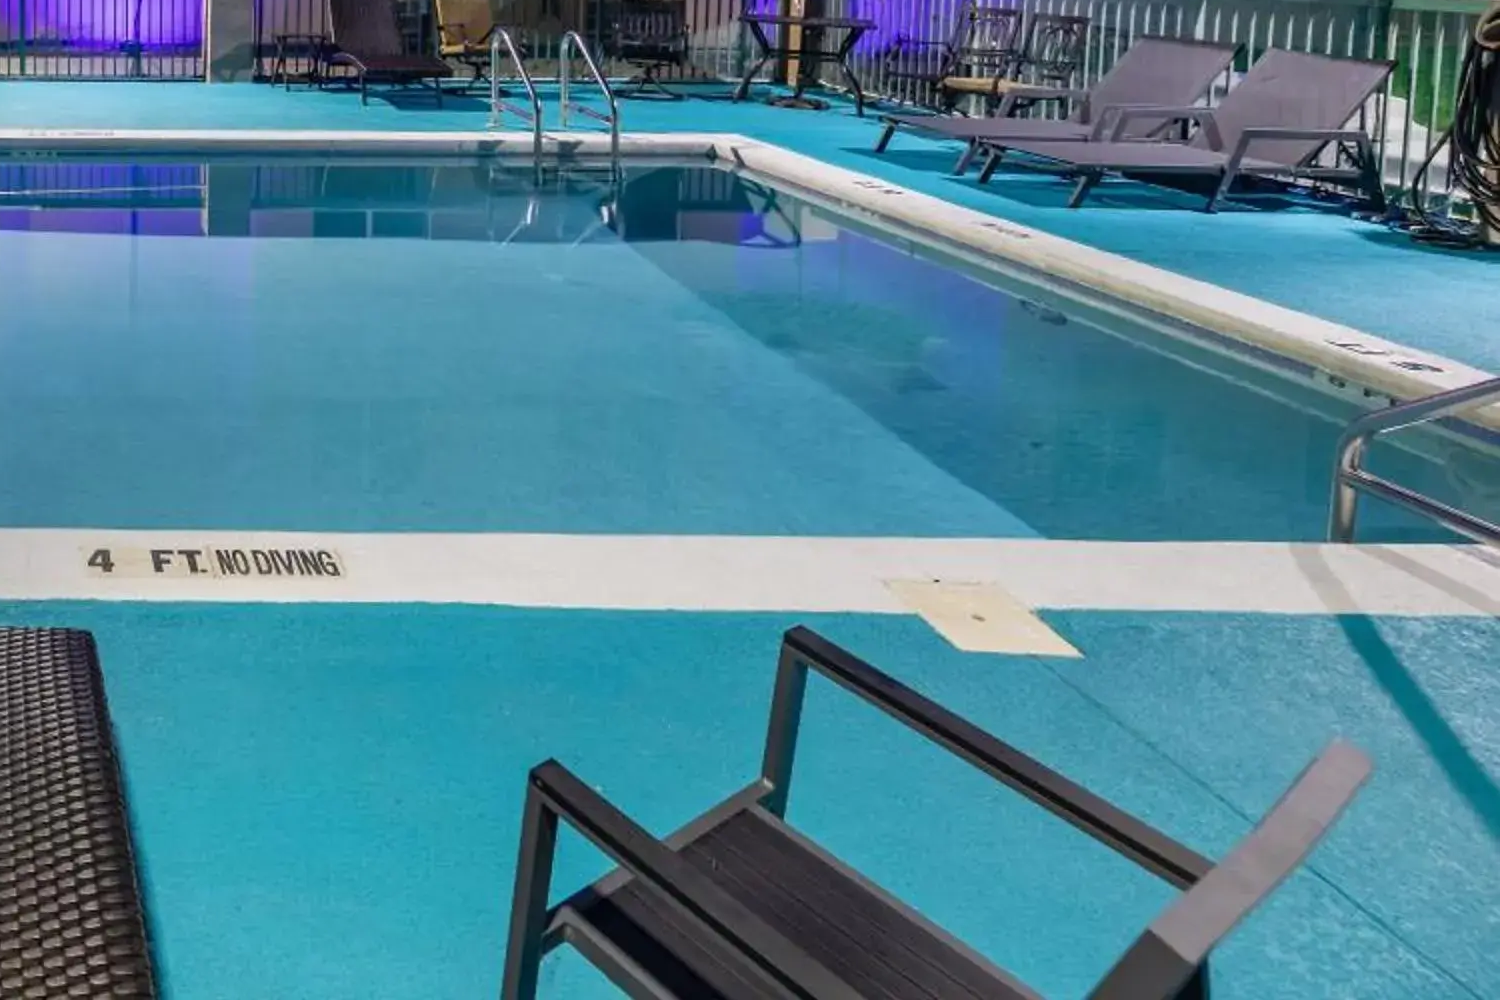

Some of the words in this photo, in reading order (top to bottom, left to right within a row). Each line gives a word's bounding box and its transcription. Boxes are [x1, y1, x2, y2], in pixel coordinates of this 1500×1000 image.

[87, 548, 115, 573] 4
[150, 549, 208, 573] FT.
[216, 549, 250, 576] NO
[252, 549, 341, 577] DIVING
